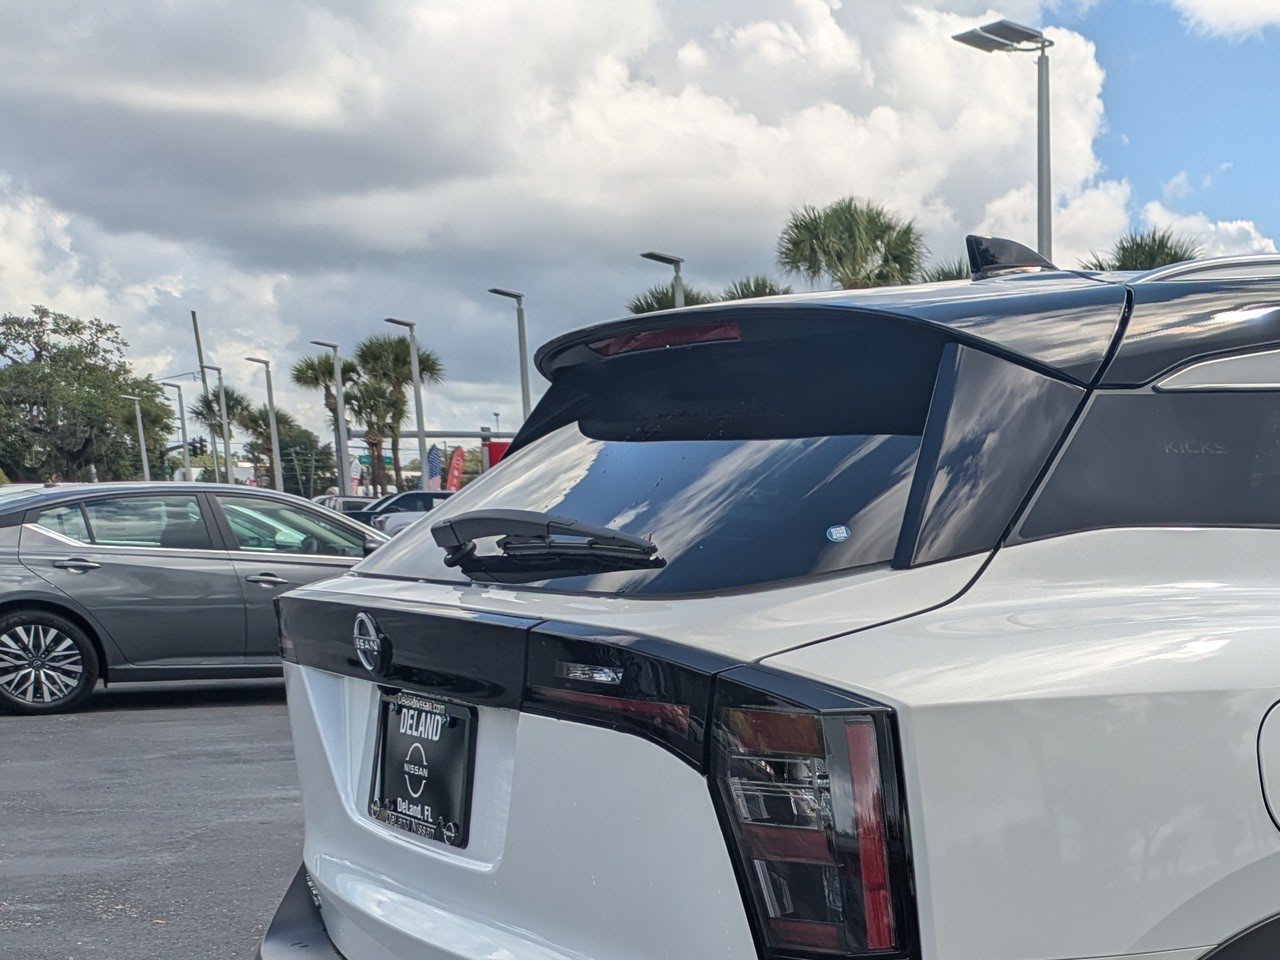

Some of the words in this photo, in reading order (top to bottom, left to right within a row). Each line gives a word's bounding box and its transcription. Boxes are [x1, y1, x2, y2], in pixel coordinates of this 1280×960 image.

[1163, 441, 1229, 455] KICKS
[400, 708, 442, 741] DELAND
[404, 763, 429, 778] NISSAN
[424, 805, 433, 822] FL
